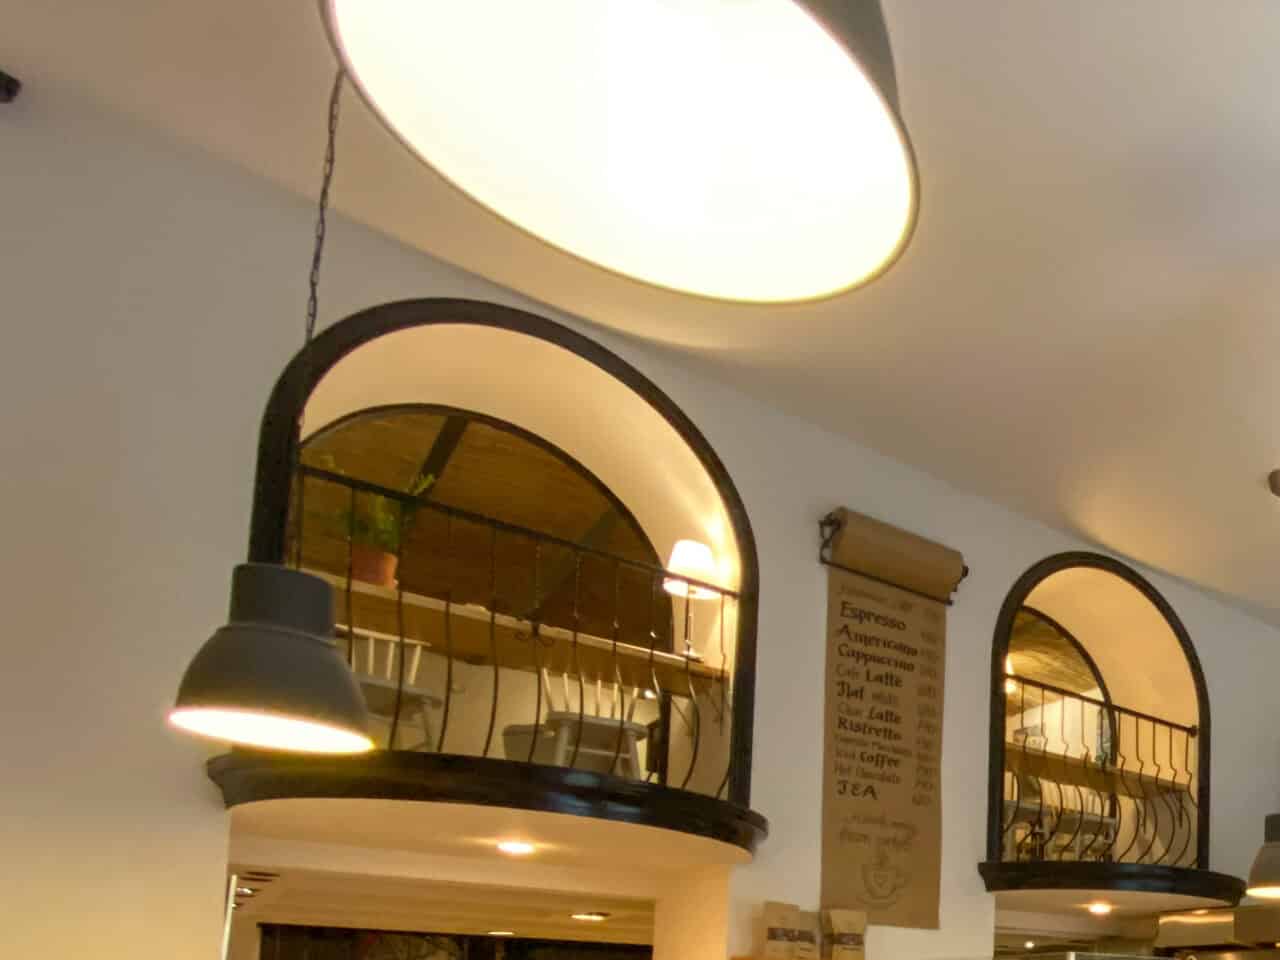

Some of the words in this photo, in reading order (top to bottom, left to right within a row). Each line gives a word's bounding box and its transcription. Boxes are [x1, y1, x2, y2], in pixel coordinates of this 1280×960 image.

[841, 601, 906, 631] Espresso
[837, 625, 918, 657] Americano
[838, 643, 915, 672] Cappuccino
[866, 669, 903, 688] Latte
[867, 706, 902, 724] Latte
[837, 716, 902, 741] Ristretto
[860, 751, 900, 769] Coffee
[837, 781, 878, 801] TEA
